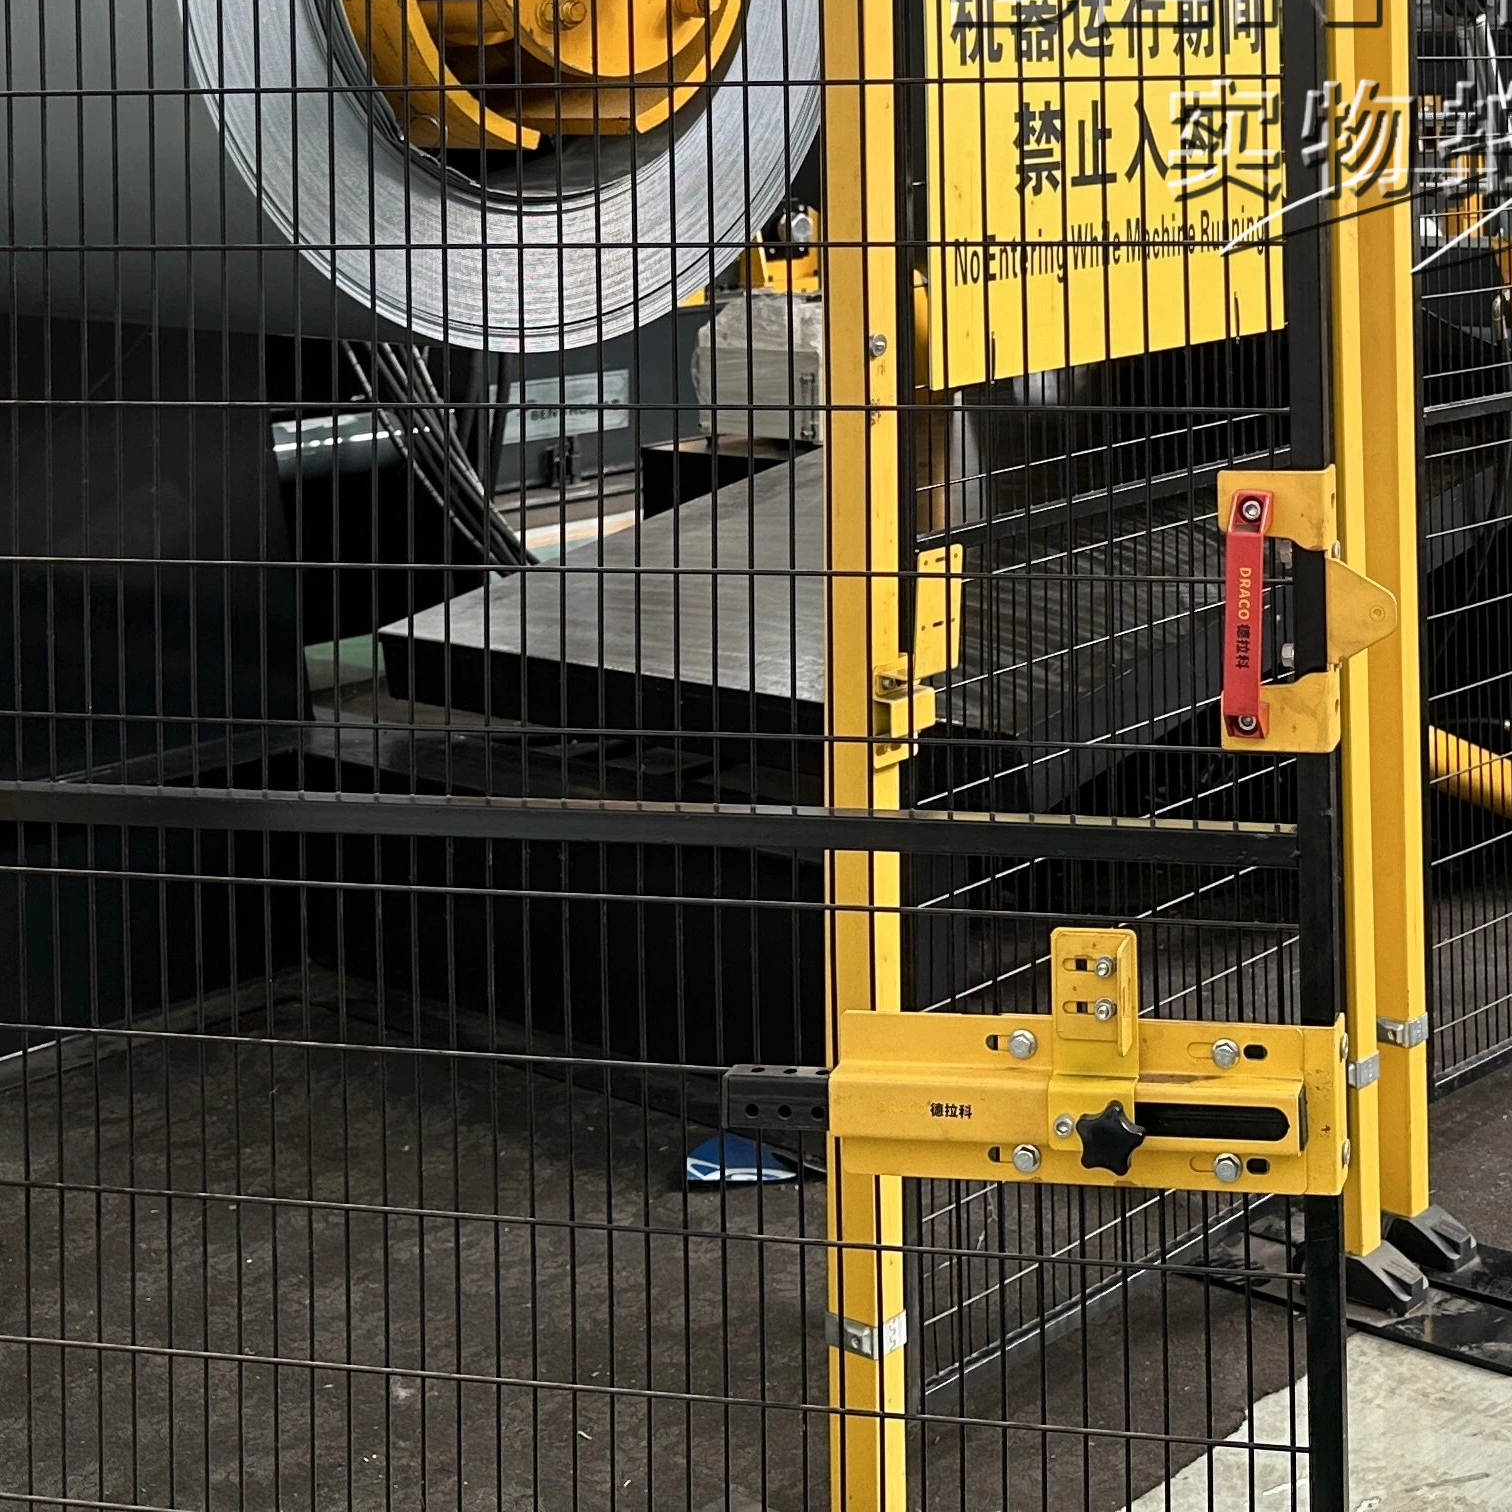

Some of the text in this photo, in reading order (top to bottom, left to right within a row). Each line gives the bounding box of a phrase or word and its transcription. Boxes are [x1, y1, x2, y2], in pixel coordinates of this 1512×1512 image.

[954, 237, 981, 287] No
[1071, 219, 1121, 270] Whle
[1201, 205, 1266, 256] Runing
[1235, 567, 1252, 669] DRACO 德拉科
[930, 1102, 973, 1119] 德拉科
